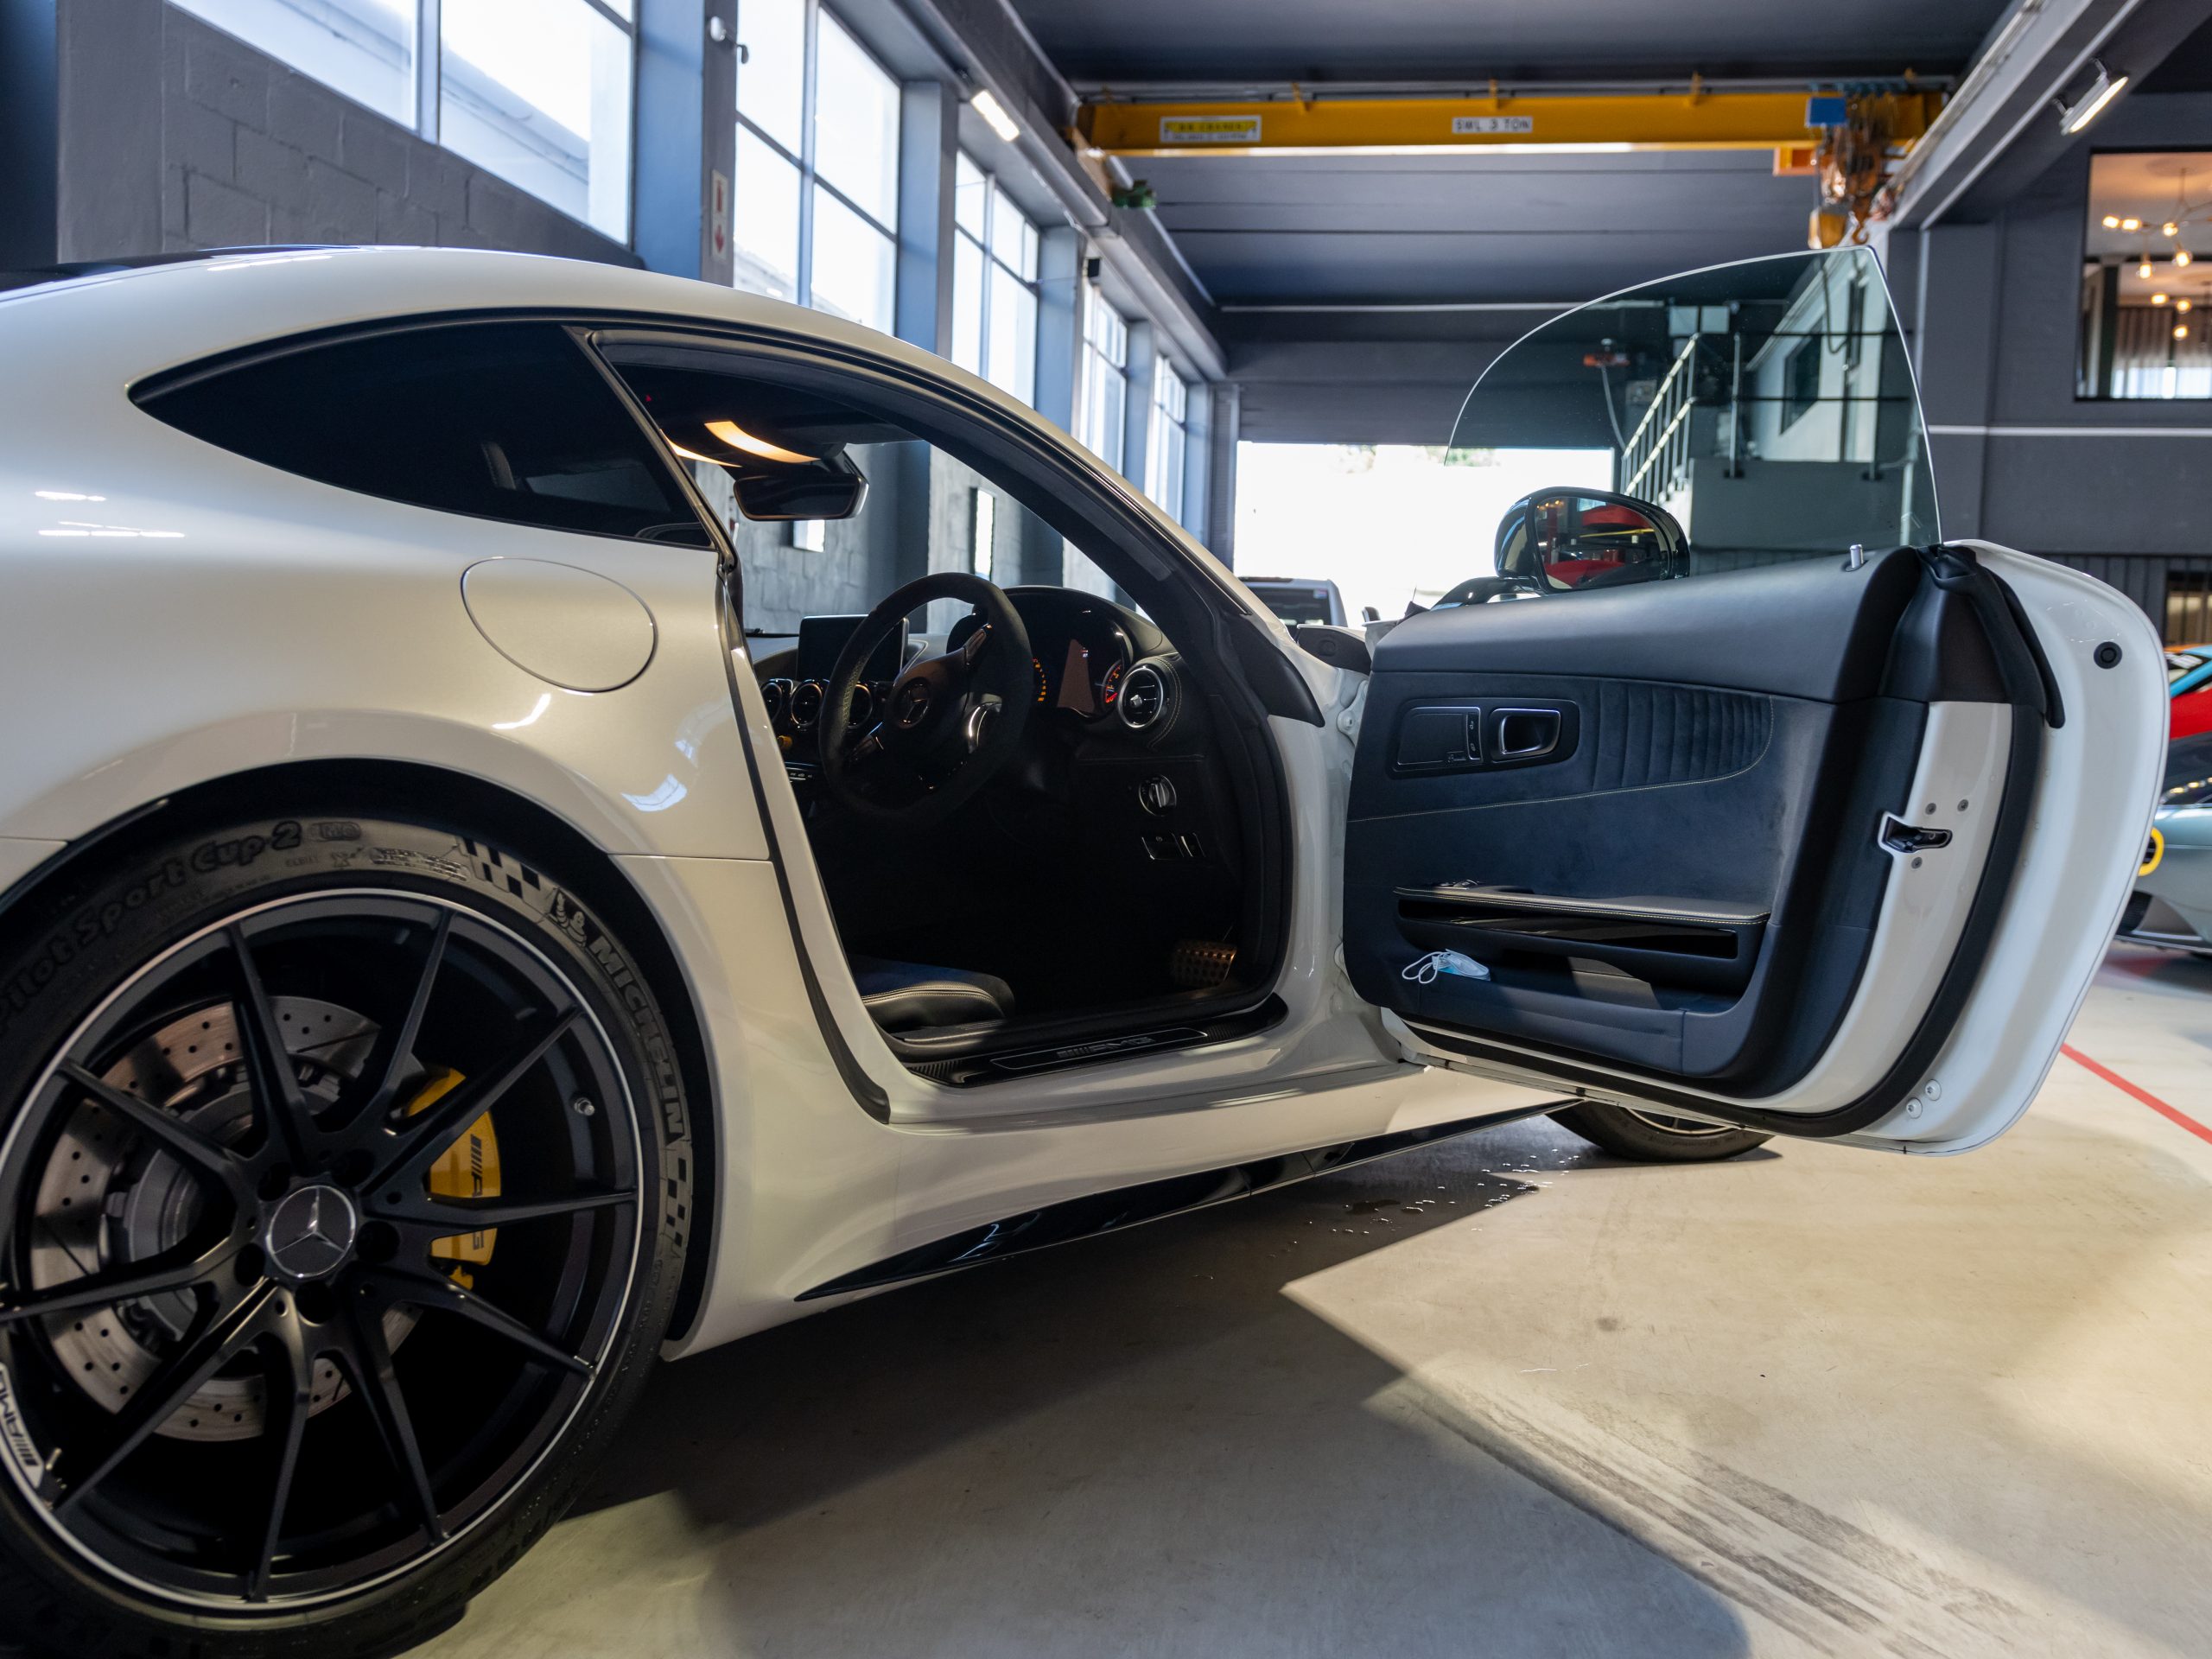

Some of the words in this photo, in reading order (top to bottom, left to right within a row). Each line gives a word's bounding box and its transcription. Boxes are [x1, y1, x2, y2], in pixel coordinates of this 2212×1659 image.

[1504, 118, 1529, 131] TON
[73, 857, 187, 949] Sport
[191, 836, 267, 873] Cup
[271, 820, 303, 850] 2
[589, 933, 686, 1135] MICHELIN
